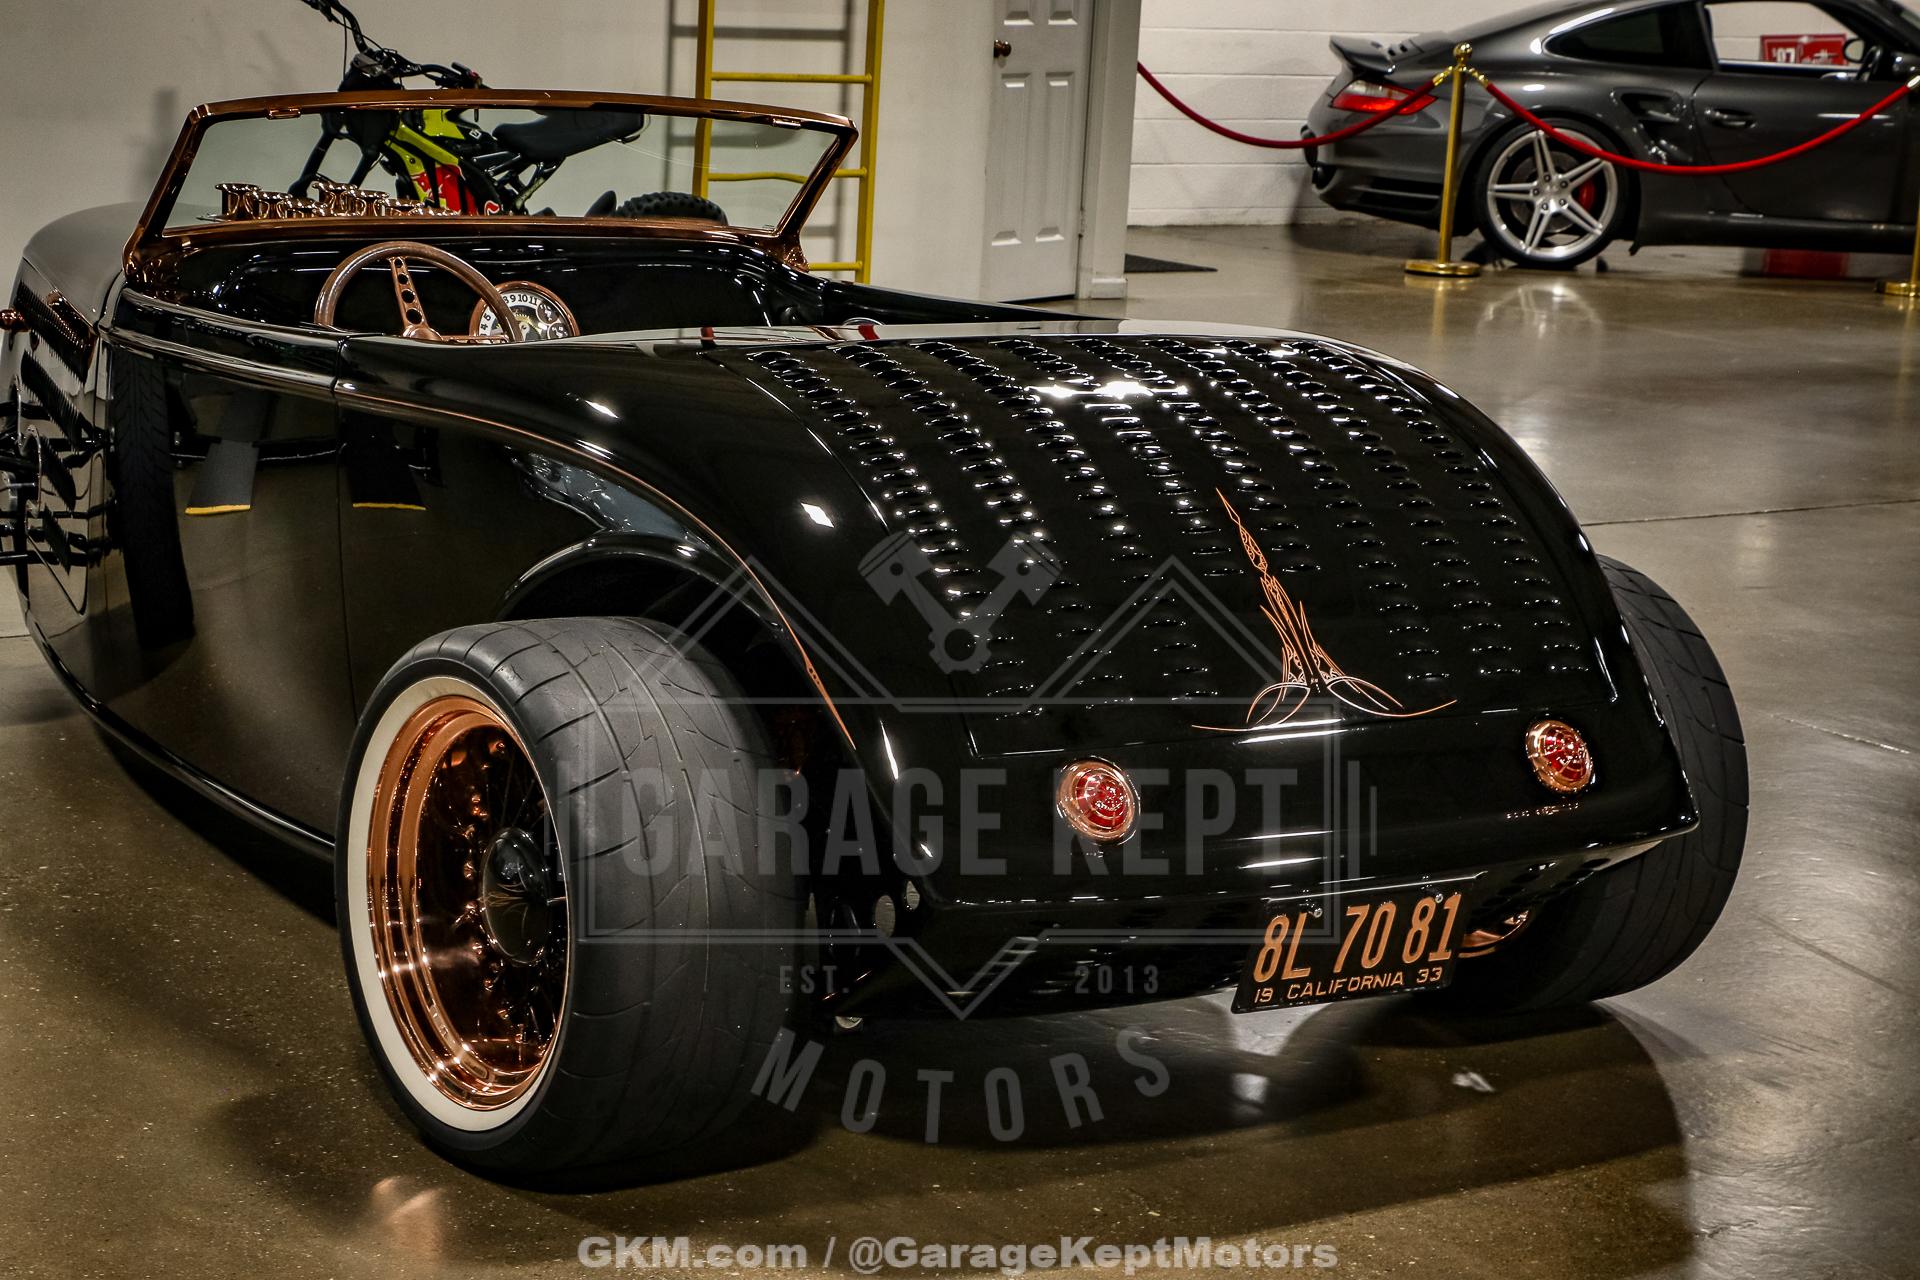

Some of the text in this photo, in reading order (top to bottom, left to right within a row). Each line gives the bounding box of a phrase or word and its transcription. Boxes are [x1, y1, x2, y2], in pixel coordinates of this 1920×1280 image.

[518, 294, 528, 303] 10
[529, 296, 538, 305] 11
[1253, 893, 1462, 983] 8L 70 81
[1254, 966, 1442, 1004] 19 CALIFORNIA 33
